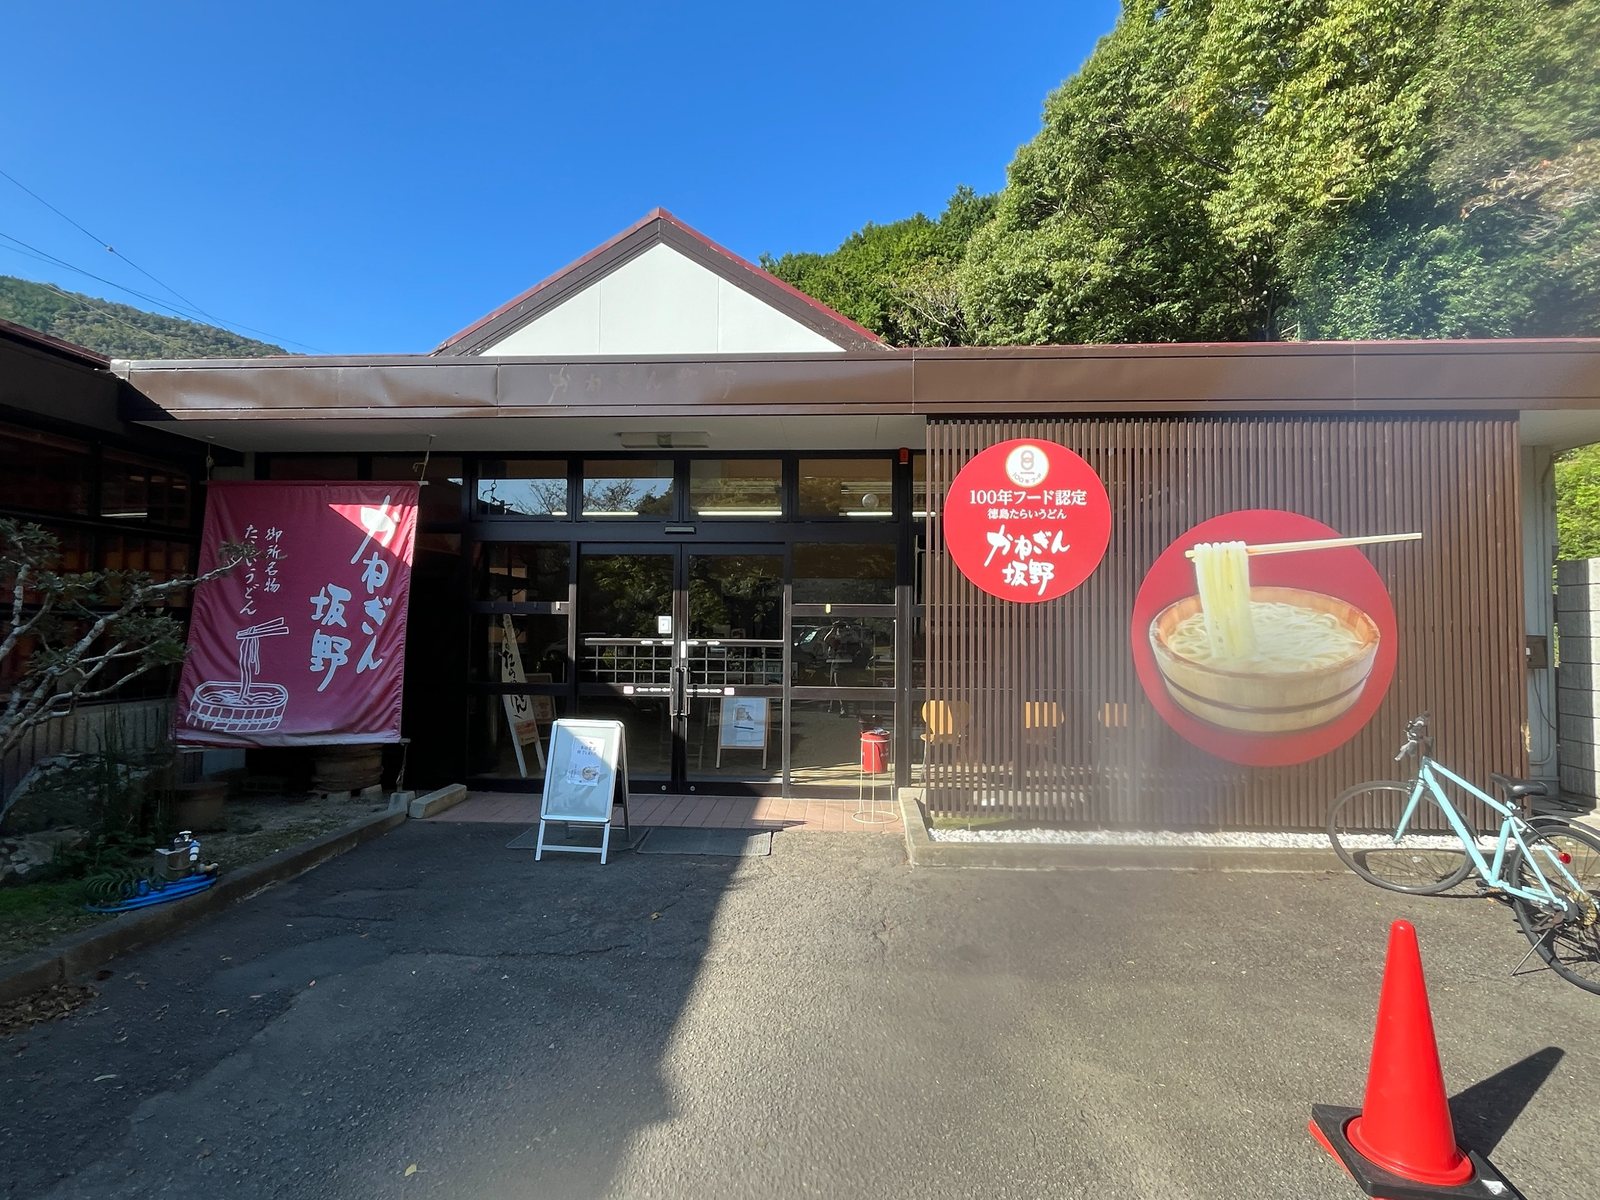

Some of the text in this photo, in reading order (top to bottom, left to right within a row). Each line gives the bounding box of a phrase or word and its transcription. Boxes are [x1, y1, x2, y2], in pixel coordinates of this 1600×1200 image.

[969, 489, 1088, 506] 100年フード認定
[987, 508, 1067, 519] 徳島たらいうどん
[239, 523, 260, 616] たいうどん
[264, 527, 283, 593] 御所名物
[984, 524, 1070, 567] かねぎん
[350, 495, 401, 674] かねぎん
[1002, 558, 1055, 596] 坂野
[309, 583, 352, 692] 坂野
